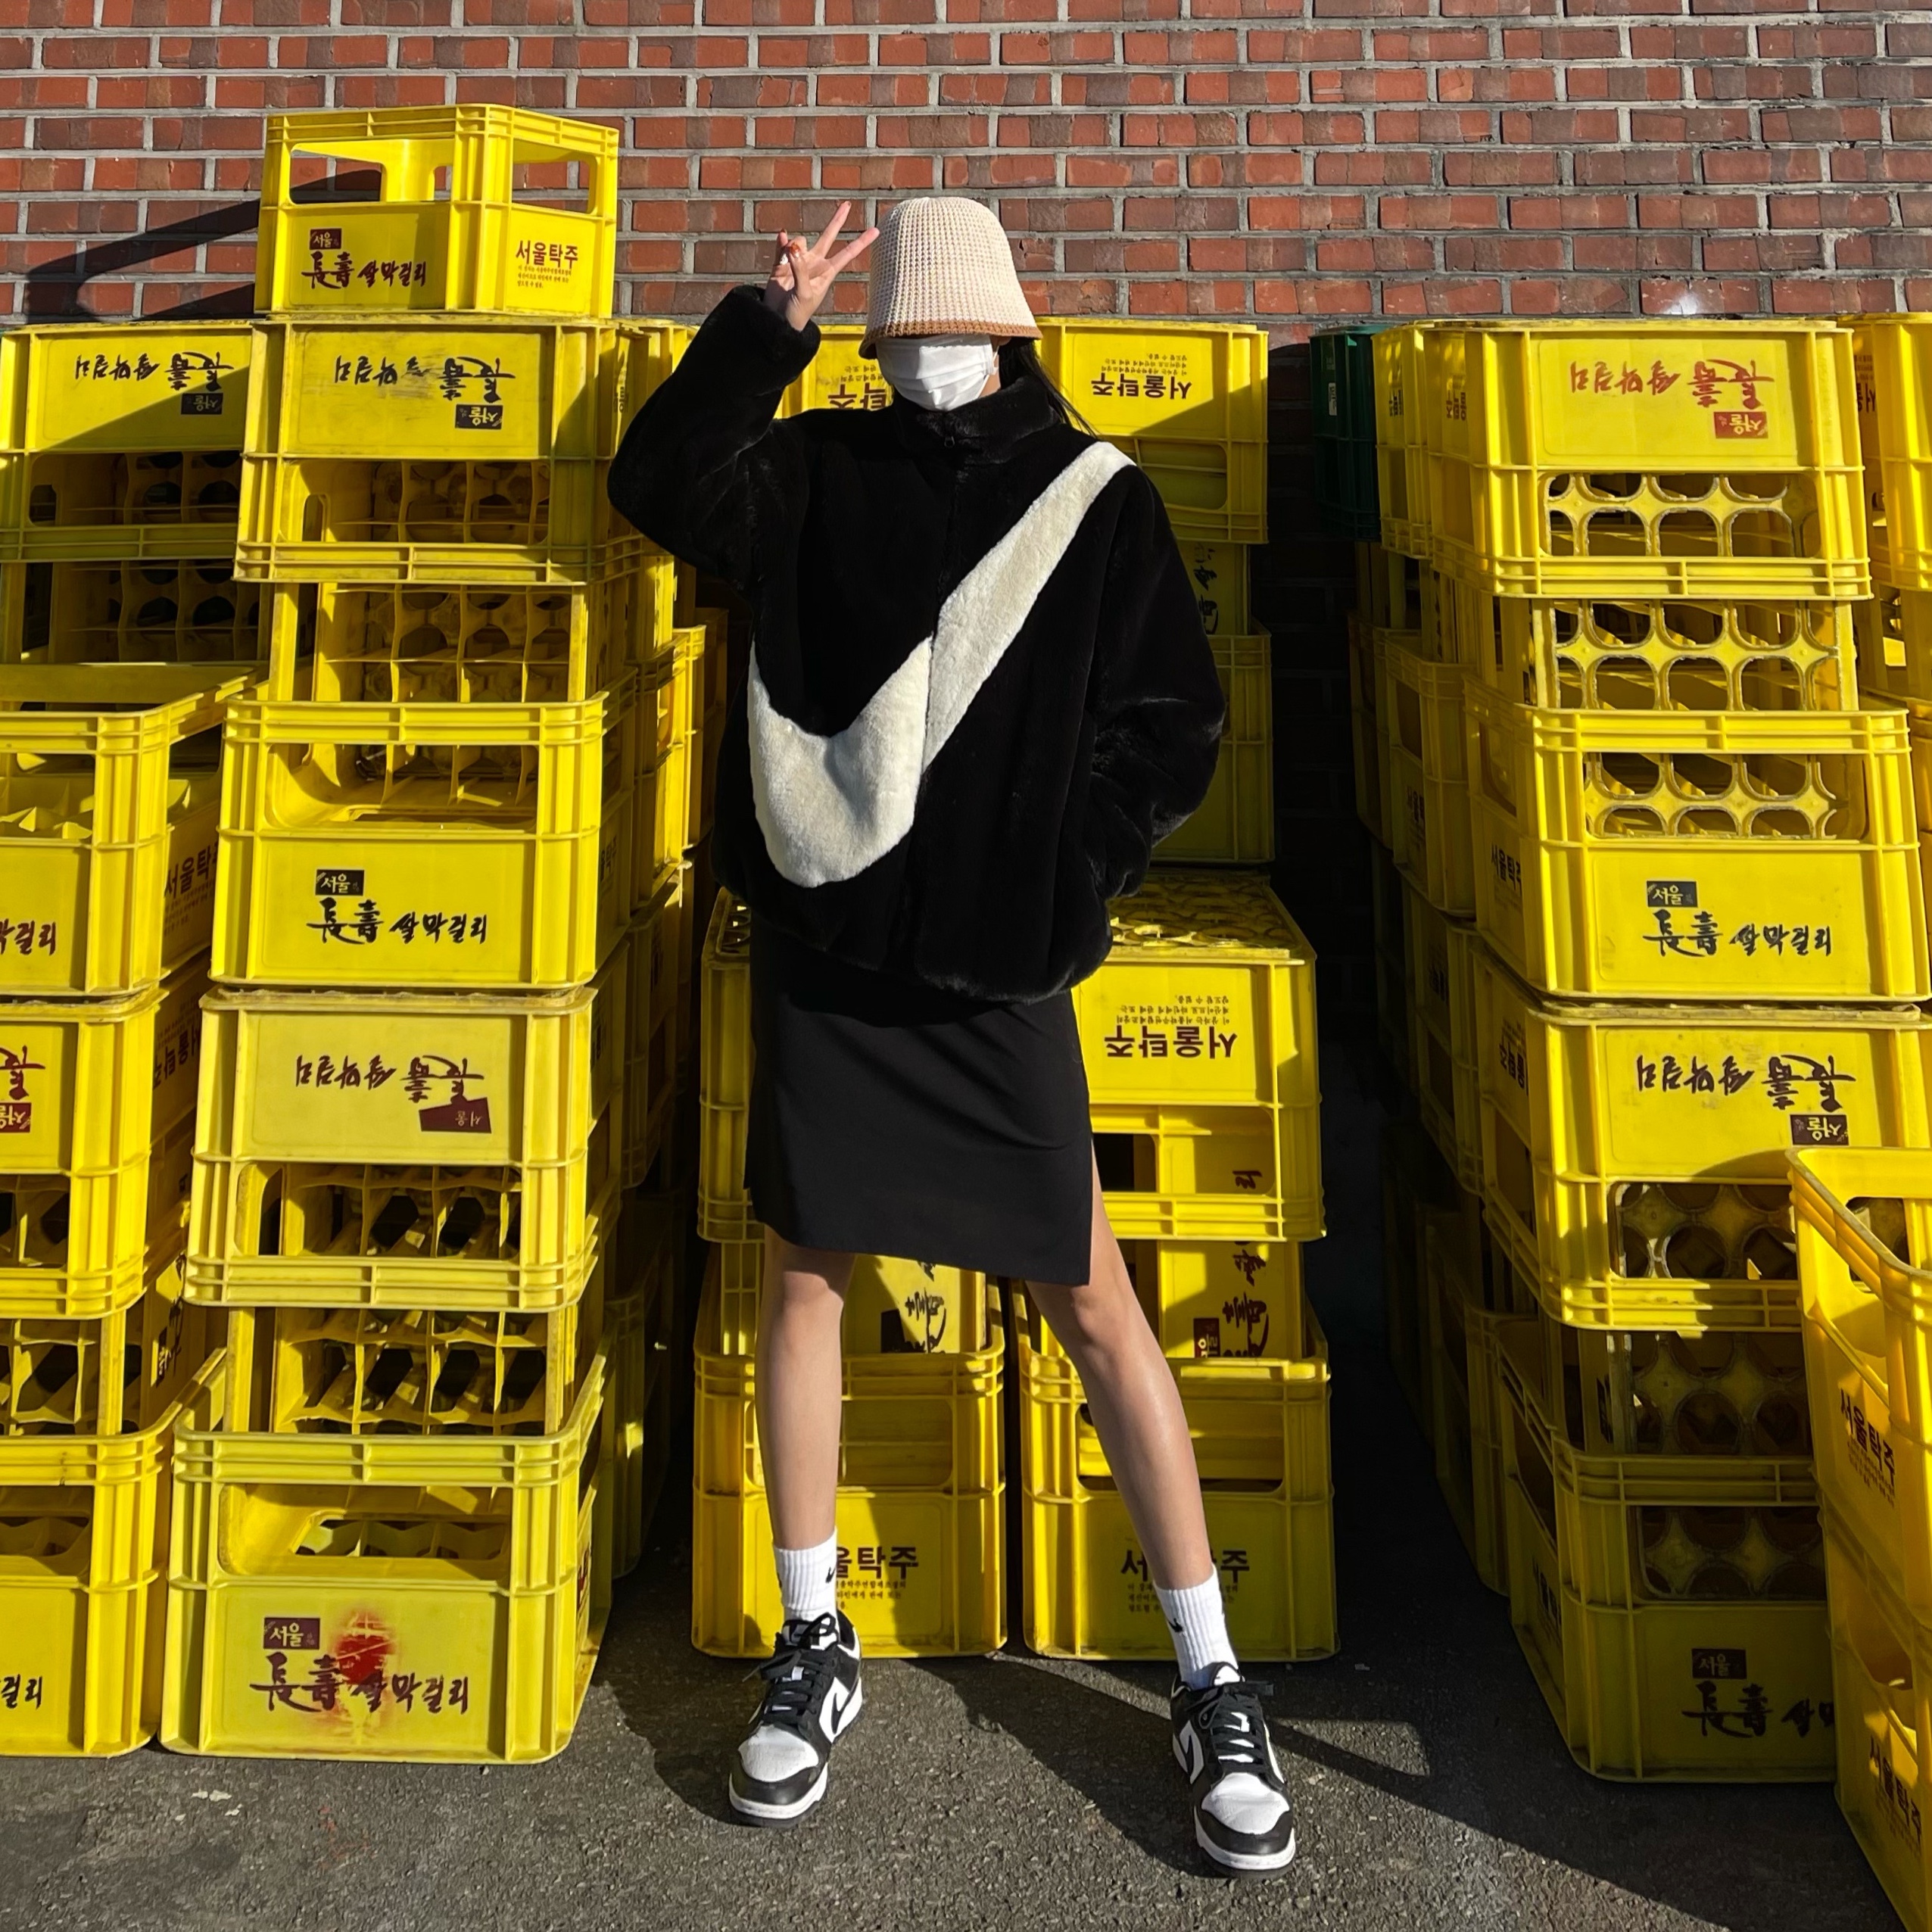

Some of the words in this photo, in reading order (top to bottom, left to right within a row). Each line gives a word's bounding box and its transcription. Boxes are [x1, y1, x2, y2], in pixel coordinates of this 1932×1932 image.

[313, 232, 332, 248] 서울
[516, 240, 578, 269] 서울탁주
[357, 260, 426, 288] 쌀막걸리
[74, 354, 160, 381] 쌀막걸리
[1569, 360, 1681, 394] 쌀막걸리
[827, 382, 887, 410] 탁주
[1091, 372, 1192, 400] 서울탁주
[193, 395, 219, 411] 서울
[469, 407, 498, 426] 서울
[1729, 414, 1762, 435] 서울
[320, 873, 351, 893] 서울
[1653, 884, 1684, 905] 서울
[0, 918, 56, 955] 막걸리
[390, 912, 488, 944] 쌀막걸리
[1729, 923, 1833, 957] 쌀막걸리
[1104, 1025, 1238, 1059] 서울탁주
[295, 1055, 396, 1089] 쌀막걸리
[1636, 1055, 1756, 1094] 쌀막걸리
[1806, 1117, 1841, 1142] 서울
[837, 1547, 919, 1579] 울탁주
[1120, 1550, 1250, 1583] 서주
[270, 1622, 304, 1647] 서울
[0, 1674, 42, 1710] 걸리
